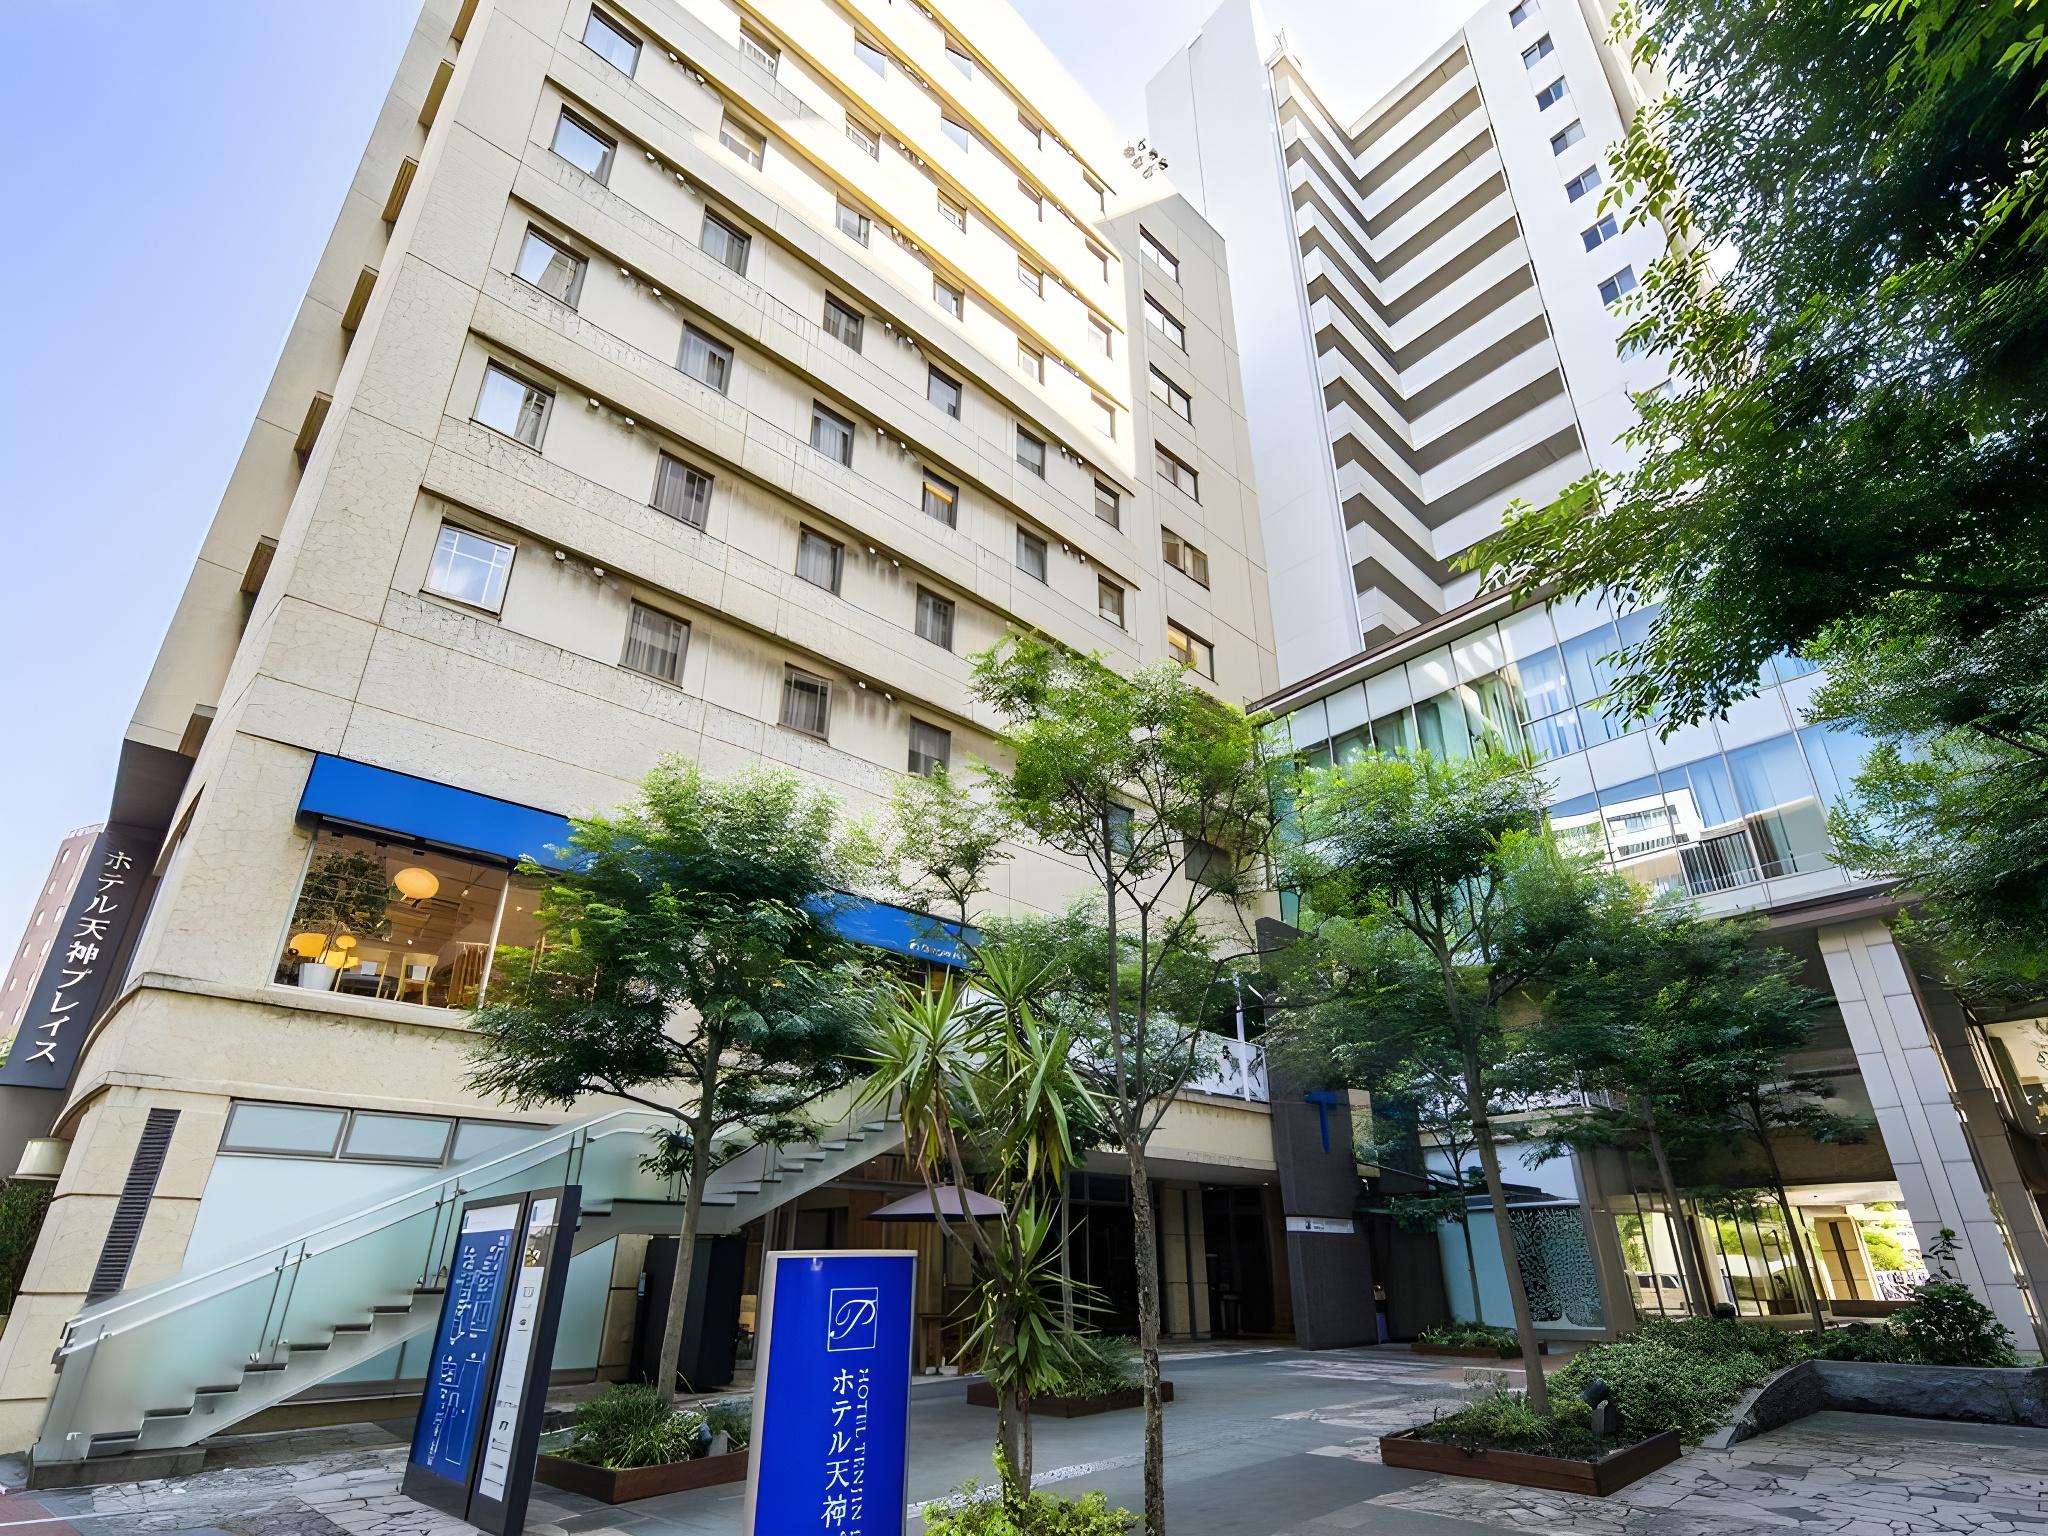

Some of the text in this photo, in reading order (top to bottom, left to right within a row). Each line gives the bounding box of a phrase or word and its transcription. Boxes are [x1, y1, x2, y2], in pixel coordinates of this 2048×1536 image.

[25, 851, 132, 1063] ホテル天神プレイス
[820, 1368, 854, 1536] ホテル天神
